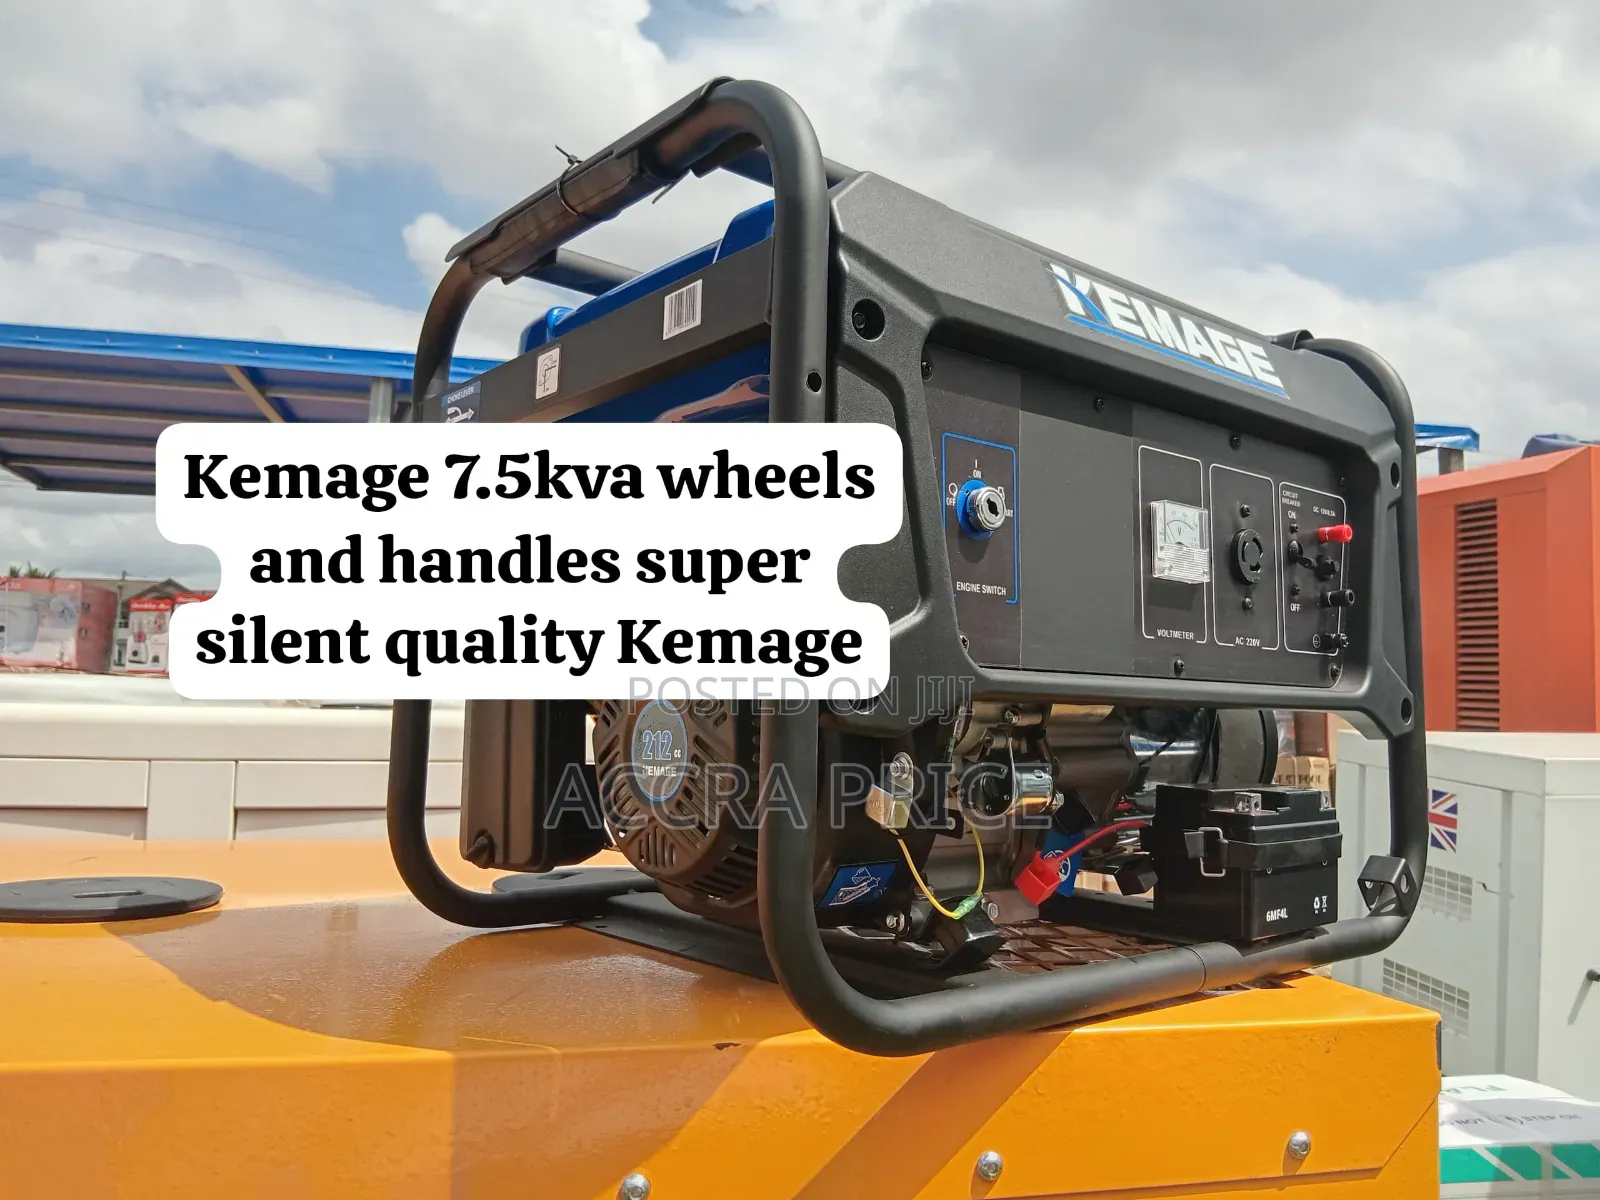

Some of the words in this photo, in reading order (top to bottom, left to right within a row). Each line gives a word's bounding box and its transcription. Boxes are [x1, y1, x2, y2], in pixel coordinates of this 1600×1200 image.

[972, 469, 982, 478] ON
[1287, 510, 1297, 520] ON
[956, 581, 981, 593] ENGINE
[981, 584, 1007, 596] SWITCH
[1290, 603, 1301, 612] OFF
[1156, 628, 1195, 640] VOLTMETER
[1234, 636, 1244, 646] AC
[1245, 637, 1261, 647] 220V
[642, 730, 673, 761] 212
[1266, 907, 1288, 922] 6MF4L
